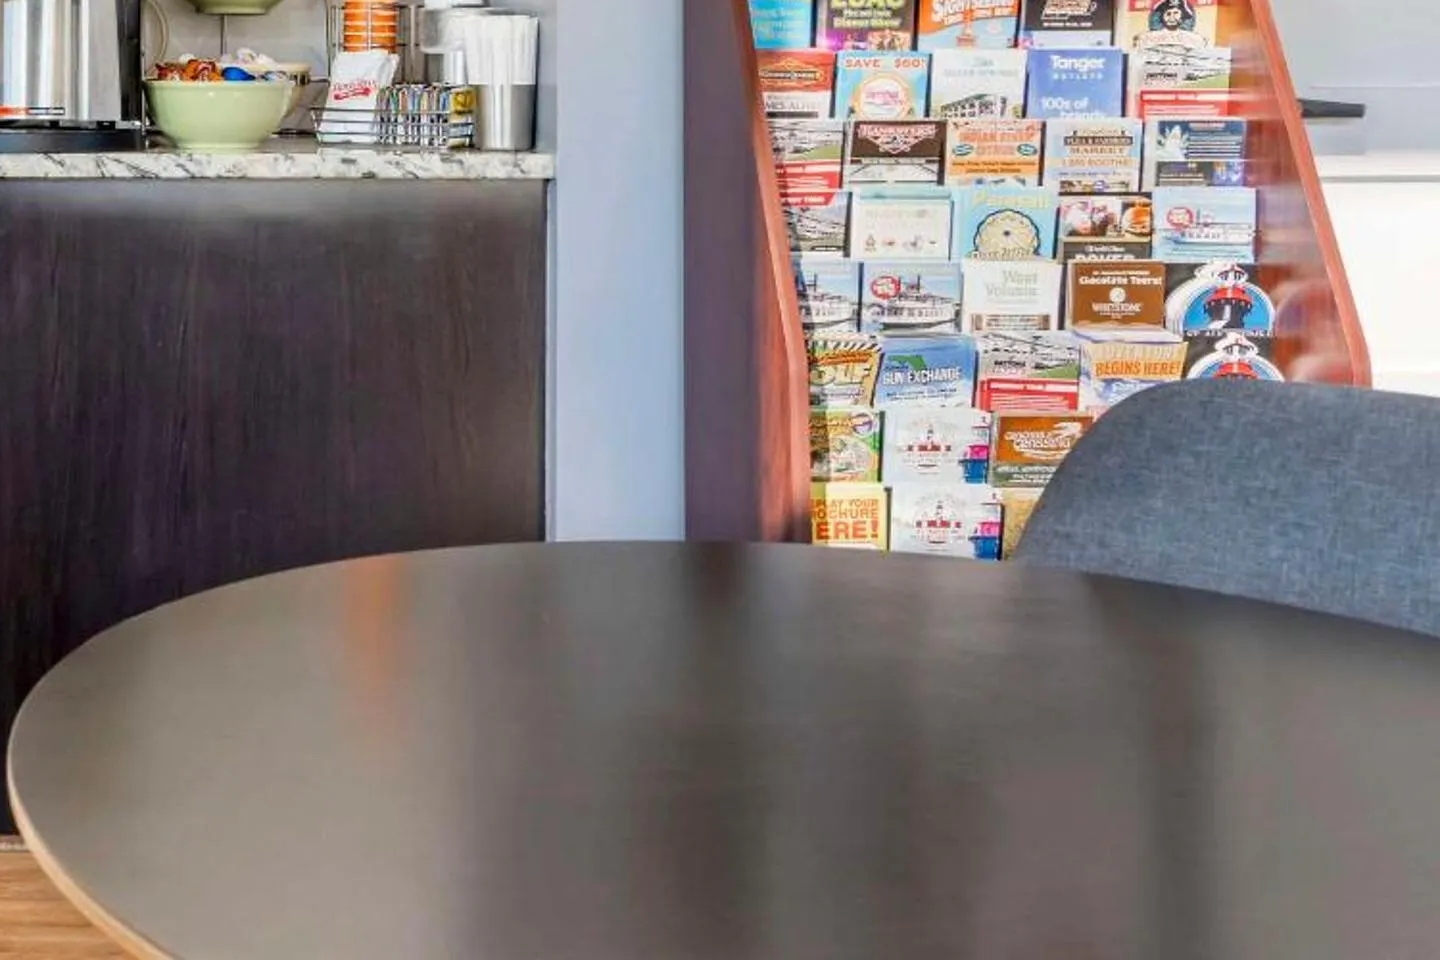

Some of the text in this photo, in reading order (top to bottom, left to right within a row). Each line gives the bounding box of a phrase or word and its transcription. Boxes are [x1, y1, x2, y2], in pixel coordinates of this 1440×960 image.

[845, 59, 880, 68] SAVE
[1049, 54, 1106, 71] Tanger
[1041, 96, 1090, 111] 100s of
[883, 366, 961, 385] GUN EXCHANGE
[1095, 360, 1181, 376] BEGINS HERE!
[849, 499, 879, 507] YOUR
[816, 520, 879, 539] ERE!
